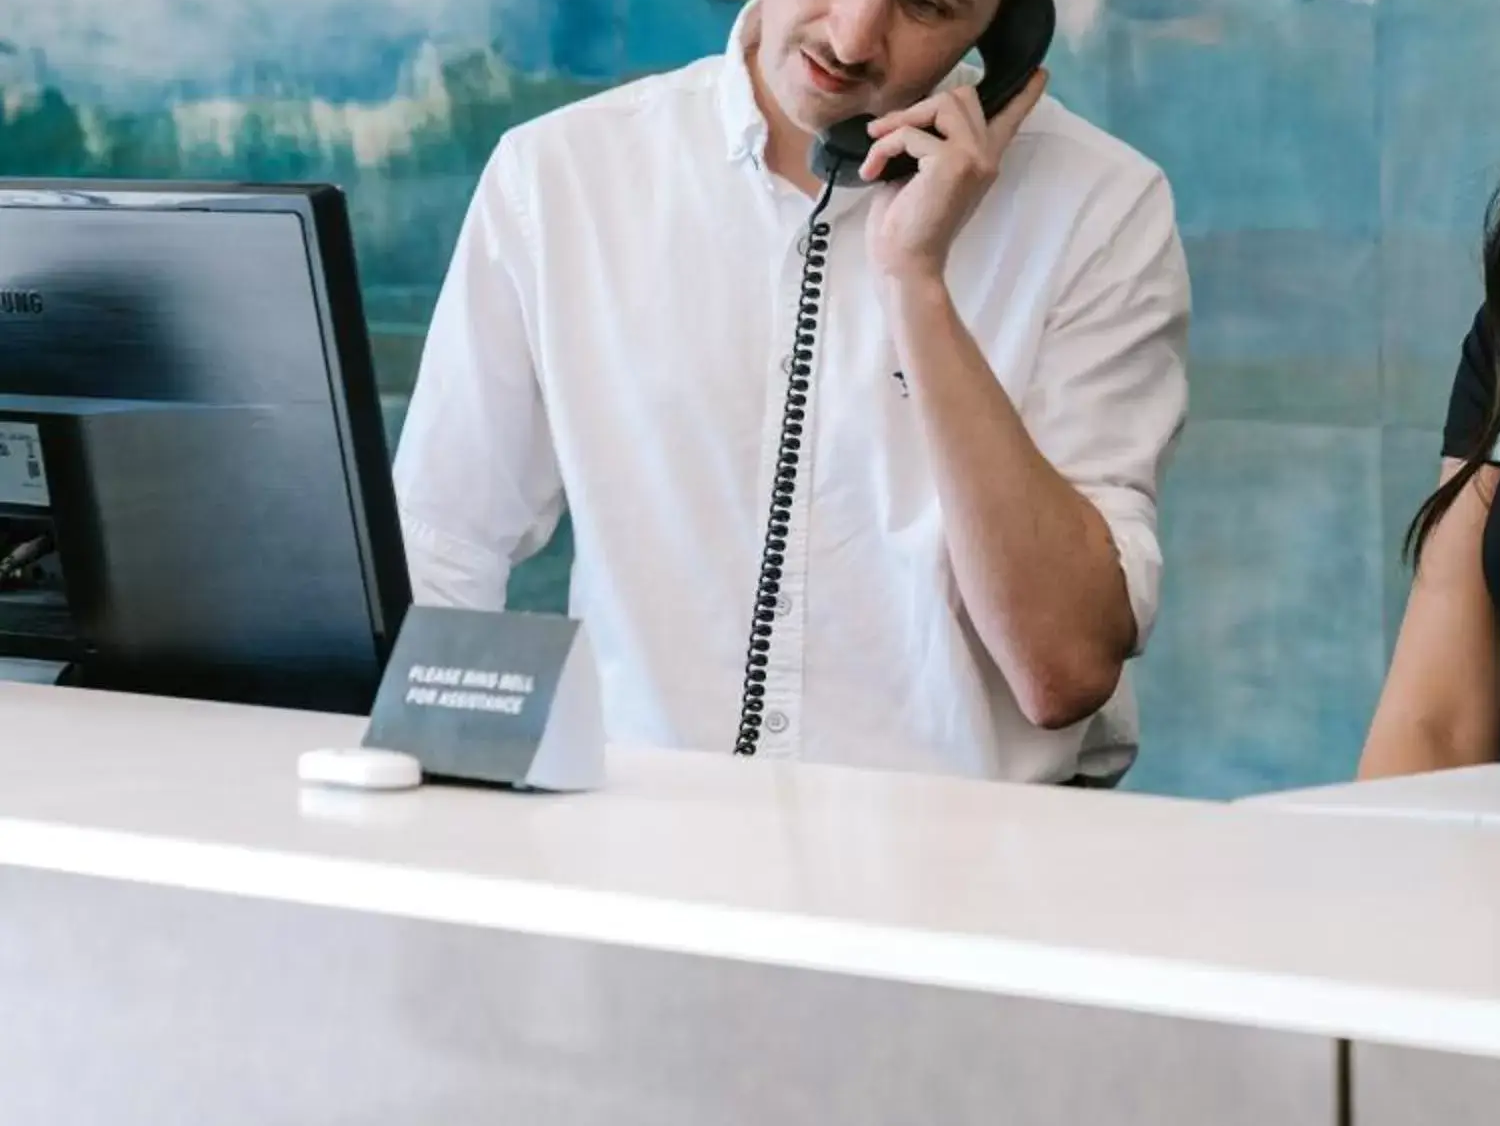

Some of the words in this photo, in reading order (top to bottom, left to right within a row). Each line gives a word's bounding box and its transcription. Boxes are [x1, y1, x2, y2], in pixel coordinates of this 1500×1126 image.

[408, 665, 462, 685] PLEASE
[499, 672, 534, 694] BELL
[405, 687, 438, 705] FOR
[437, 689, 524, 715] ASSISTANCE
